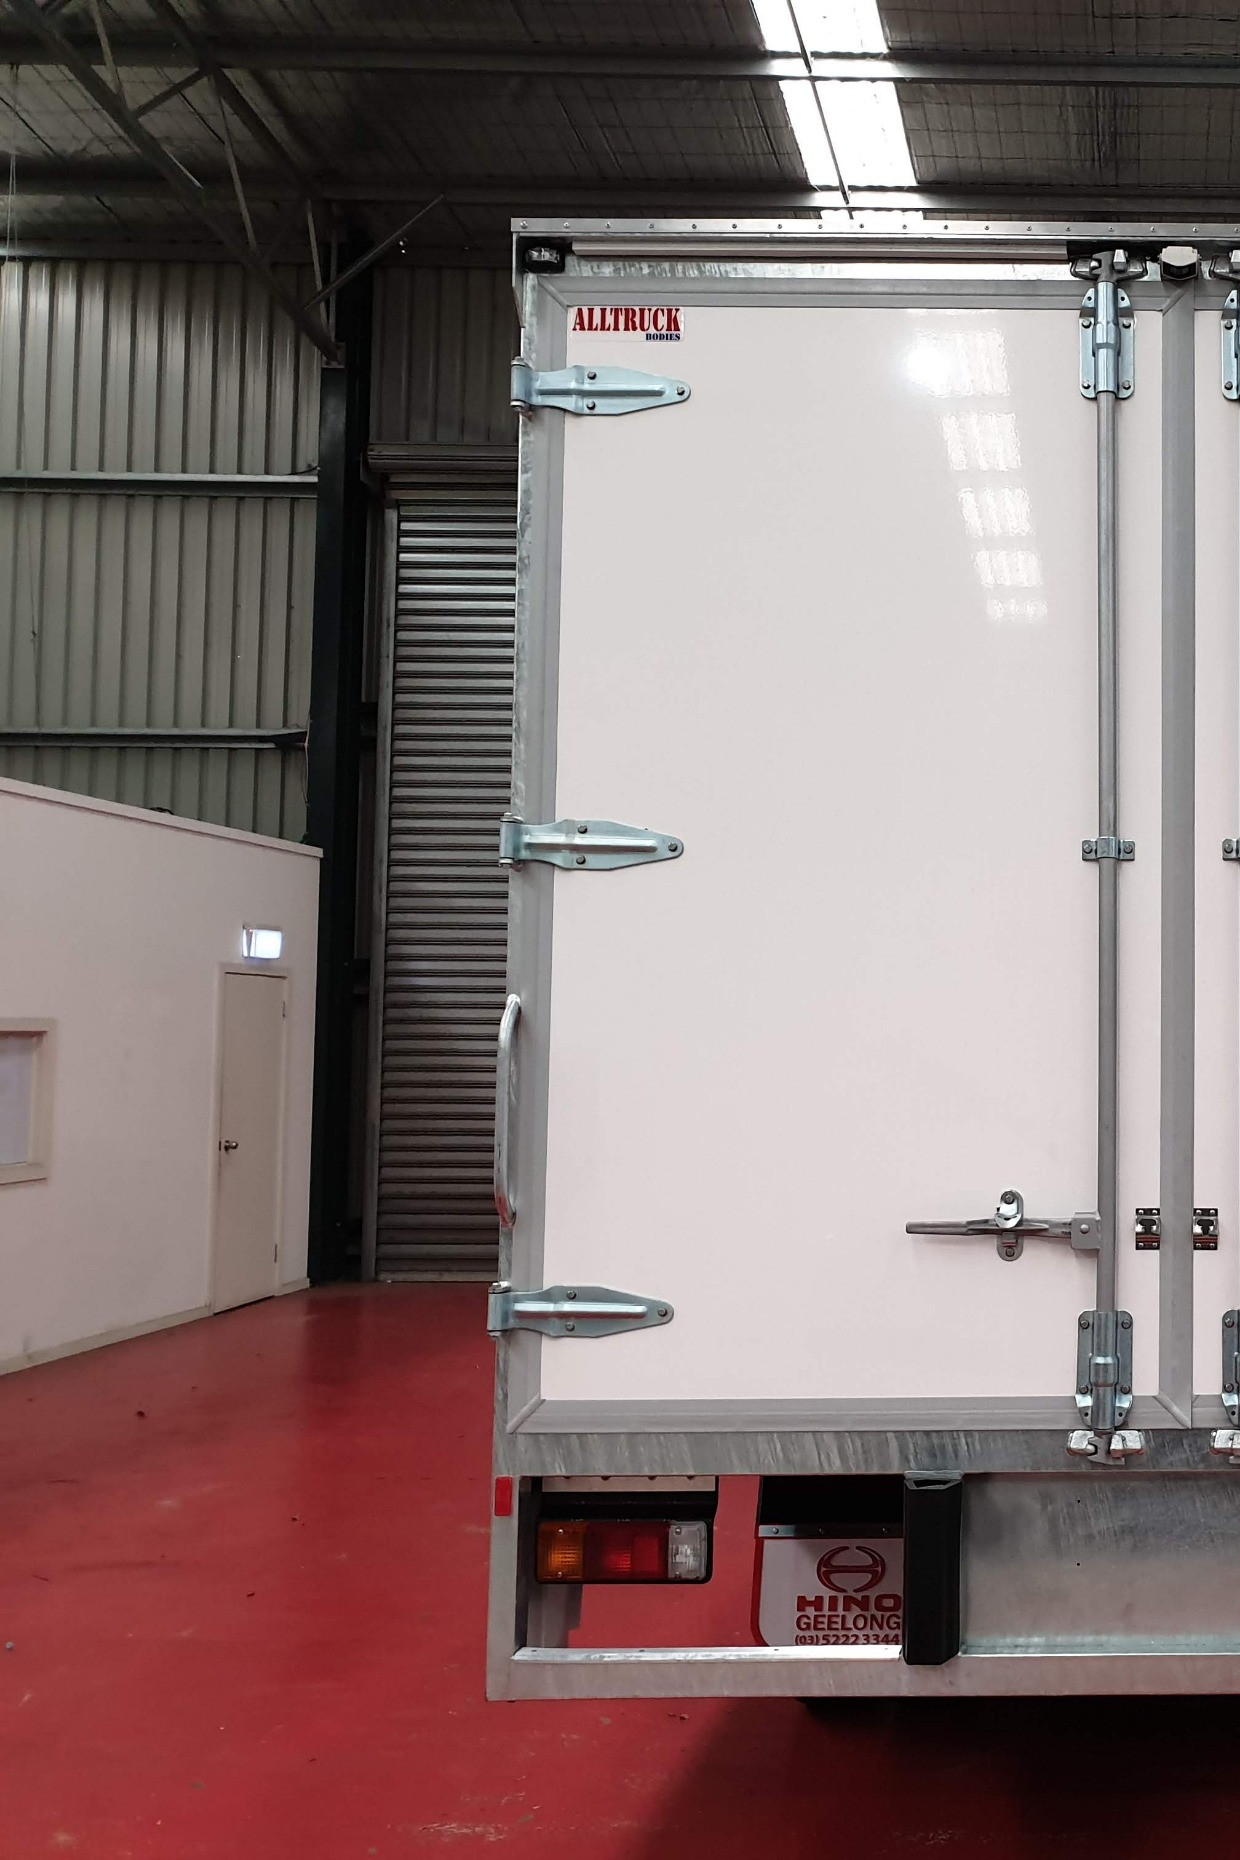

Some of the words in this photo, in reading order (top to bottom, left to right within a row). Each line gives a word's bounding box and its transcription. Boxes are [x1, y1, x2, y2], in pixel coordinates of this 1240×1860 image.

[572, 307, 681, 332] ALLTRUCK
[645, 333, 681, 341] BODIES
[796, 1594, 902, 1612] HINO
[795, 1614, 901, 1631] GEELONG
